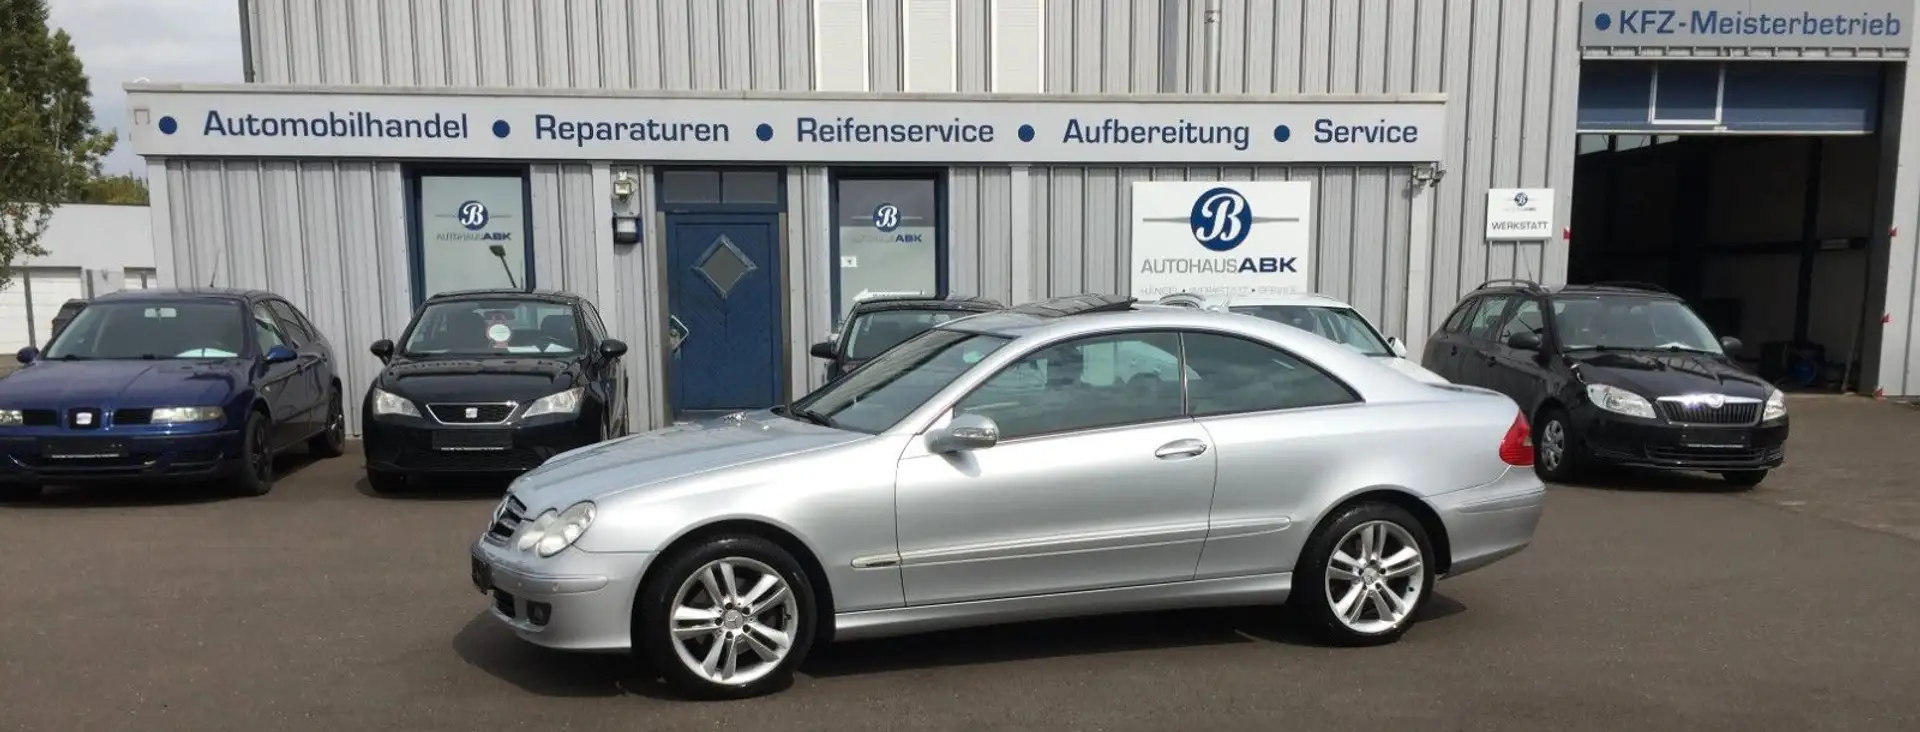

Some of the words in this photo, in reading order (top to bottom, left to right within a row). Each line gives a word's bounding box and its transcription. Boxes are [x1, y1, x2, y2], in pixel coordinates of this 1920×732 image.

[1618, 9, 1902, 36] KFZ-Meisterbetrieb
[203, 109, 468, 139] Automobilhandel
[535, 113, 730, 147] Reparaturen
[796, 117, 994, 144] Reifenservice
[1062, 119, 1250, 151] Aufbereitung
[1314, 119, 1418, 144] Service
[1195, 193, 1244, 241] B
[1491, 221, 1548, 231] WERKSTATT
[1141, 256, 1298, 274] AUTOHAUSABK
